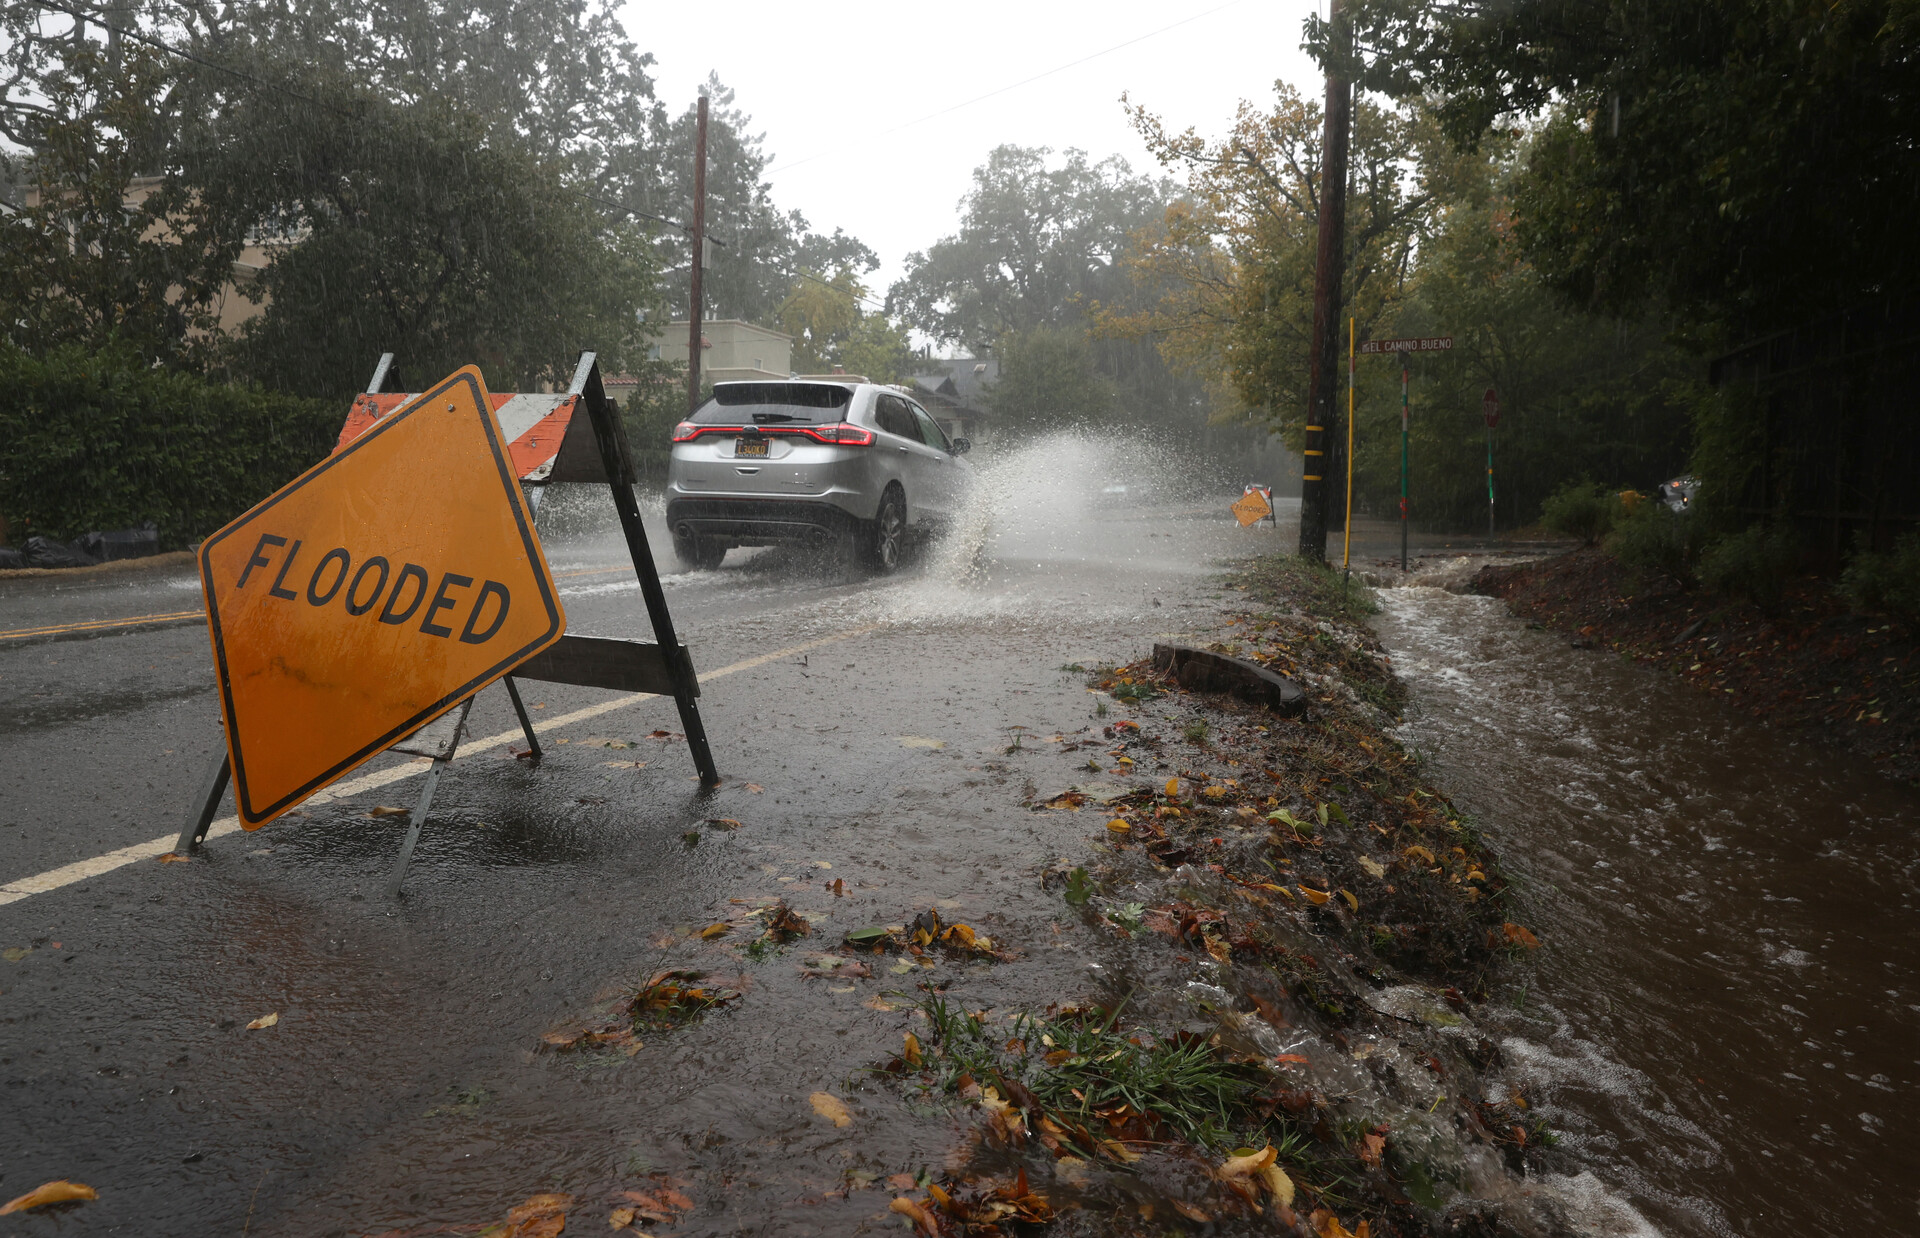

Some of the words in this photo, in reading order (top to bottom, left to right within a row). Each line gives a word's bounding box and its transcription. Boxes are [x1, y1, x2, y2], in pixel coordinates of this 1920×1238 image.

[1370, 342, 1381, 353] EL
[1384, 340, 1418, 352] CAMINO
[1421, 338, 1452, 350] BUENO
[236, 533, 511, 645] FLOODED
